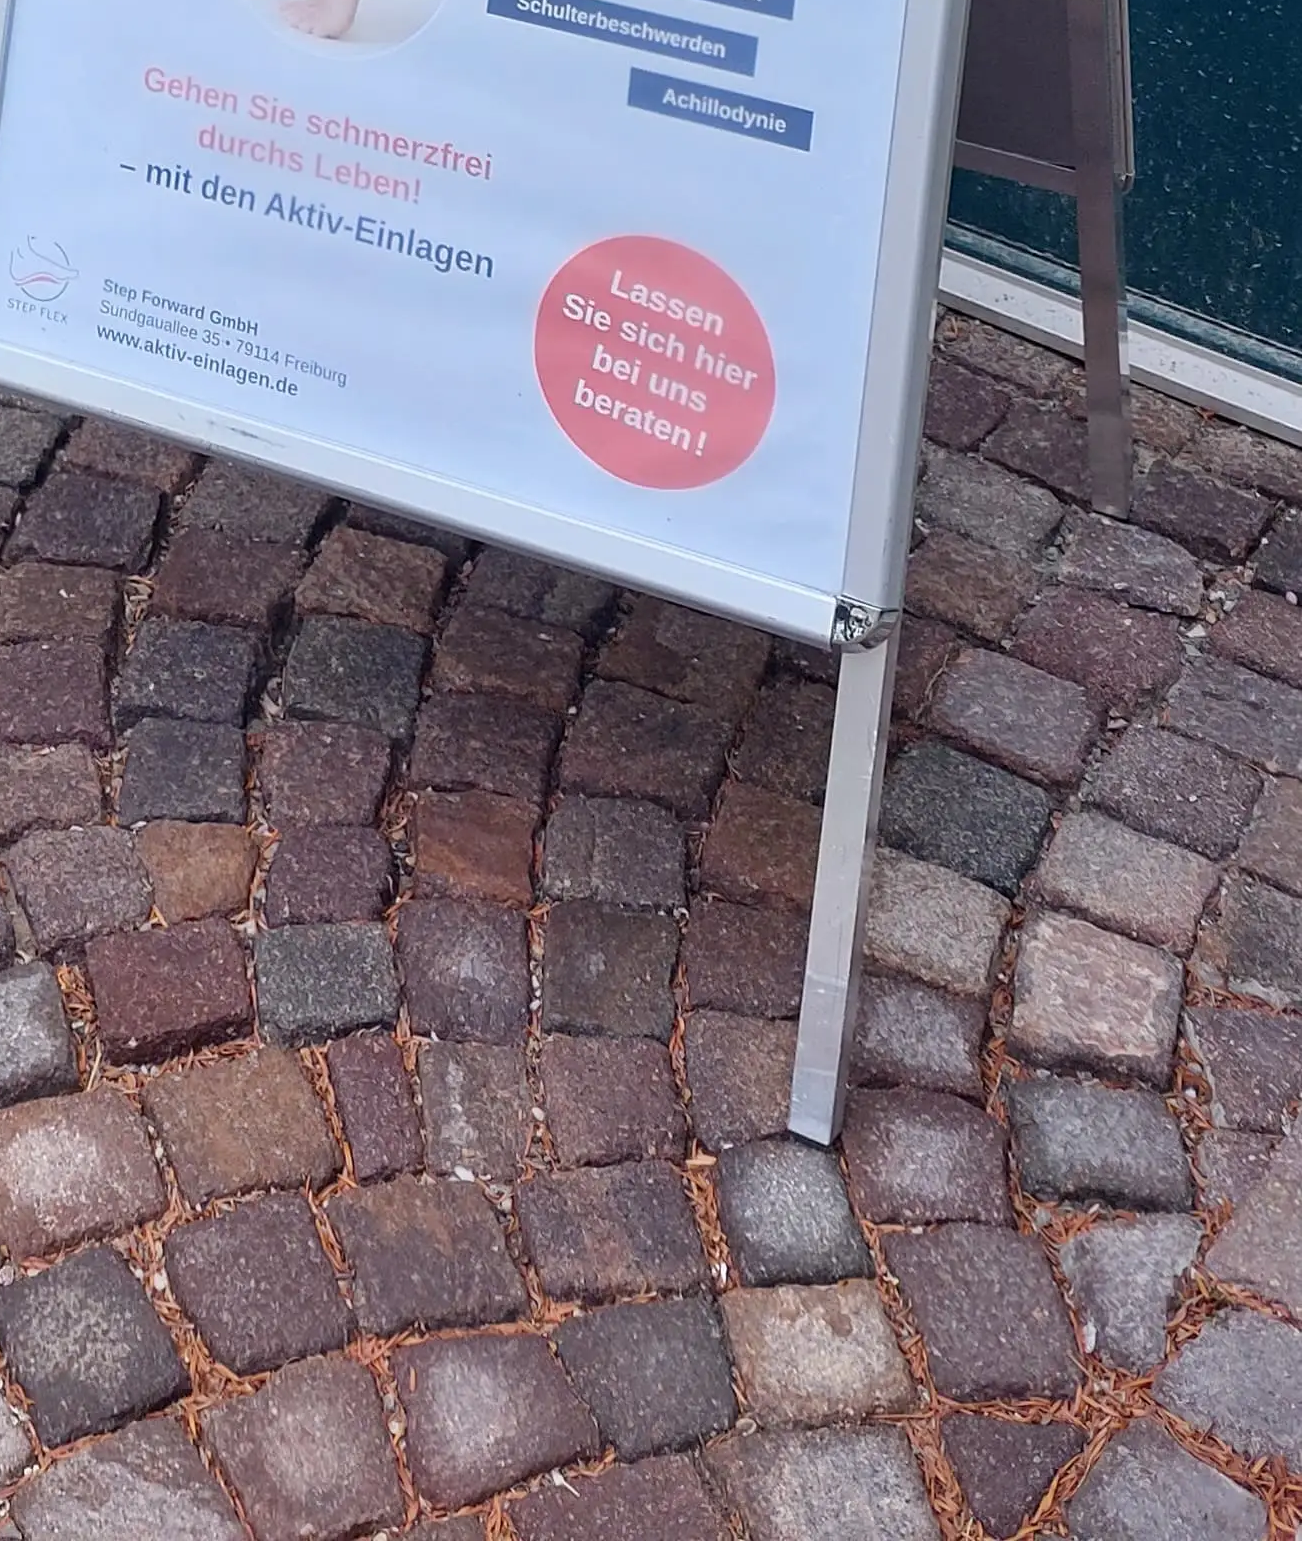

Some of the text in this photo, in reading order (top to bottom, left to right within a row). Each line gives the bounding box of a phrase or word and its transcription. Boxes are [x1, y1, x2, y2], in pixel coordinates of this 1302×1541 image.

[144, 66, 493, 180] Gehen Sie schmerzfrei
[661, 85, 788, 138] Achillodynie
[198, 125, 422, 205] durchs Leben!
[145, 161, 193, 194] mit
[201, 175, 256, 212] den
[264, 193, 495, 278] Aktiv-Einlagen
[7, 297, 68, 325] STEP FLEX
[102, 278, 260, 337] Step Forward GmbH
[610, 269, 724, 337] Lassen
[96, 324, 299, 397] www.aktiv-einlagen.de
[99, 299, 198, 340] Sundgauallee
[201, 330, 221, 347] 35
[236, 338, 280, 366] 79114
[284, 353, 348, 388] Freiburg
[562, 293, 759, 391] Sie sich hier
[592, 344, 707, 413] bei uns
